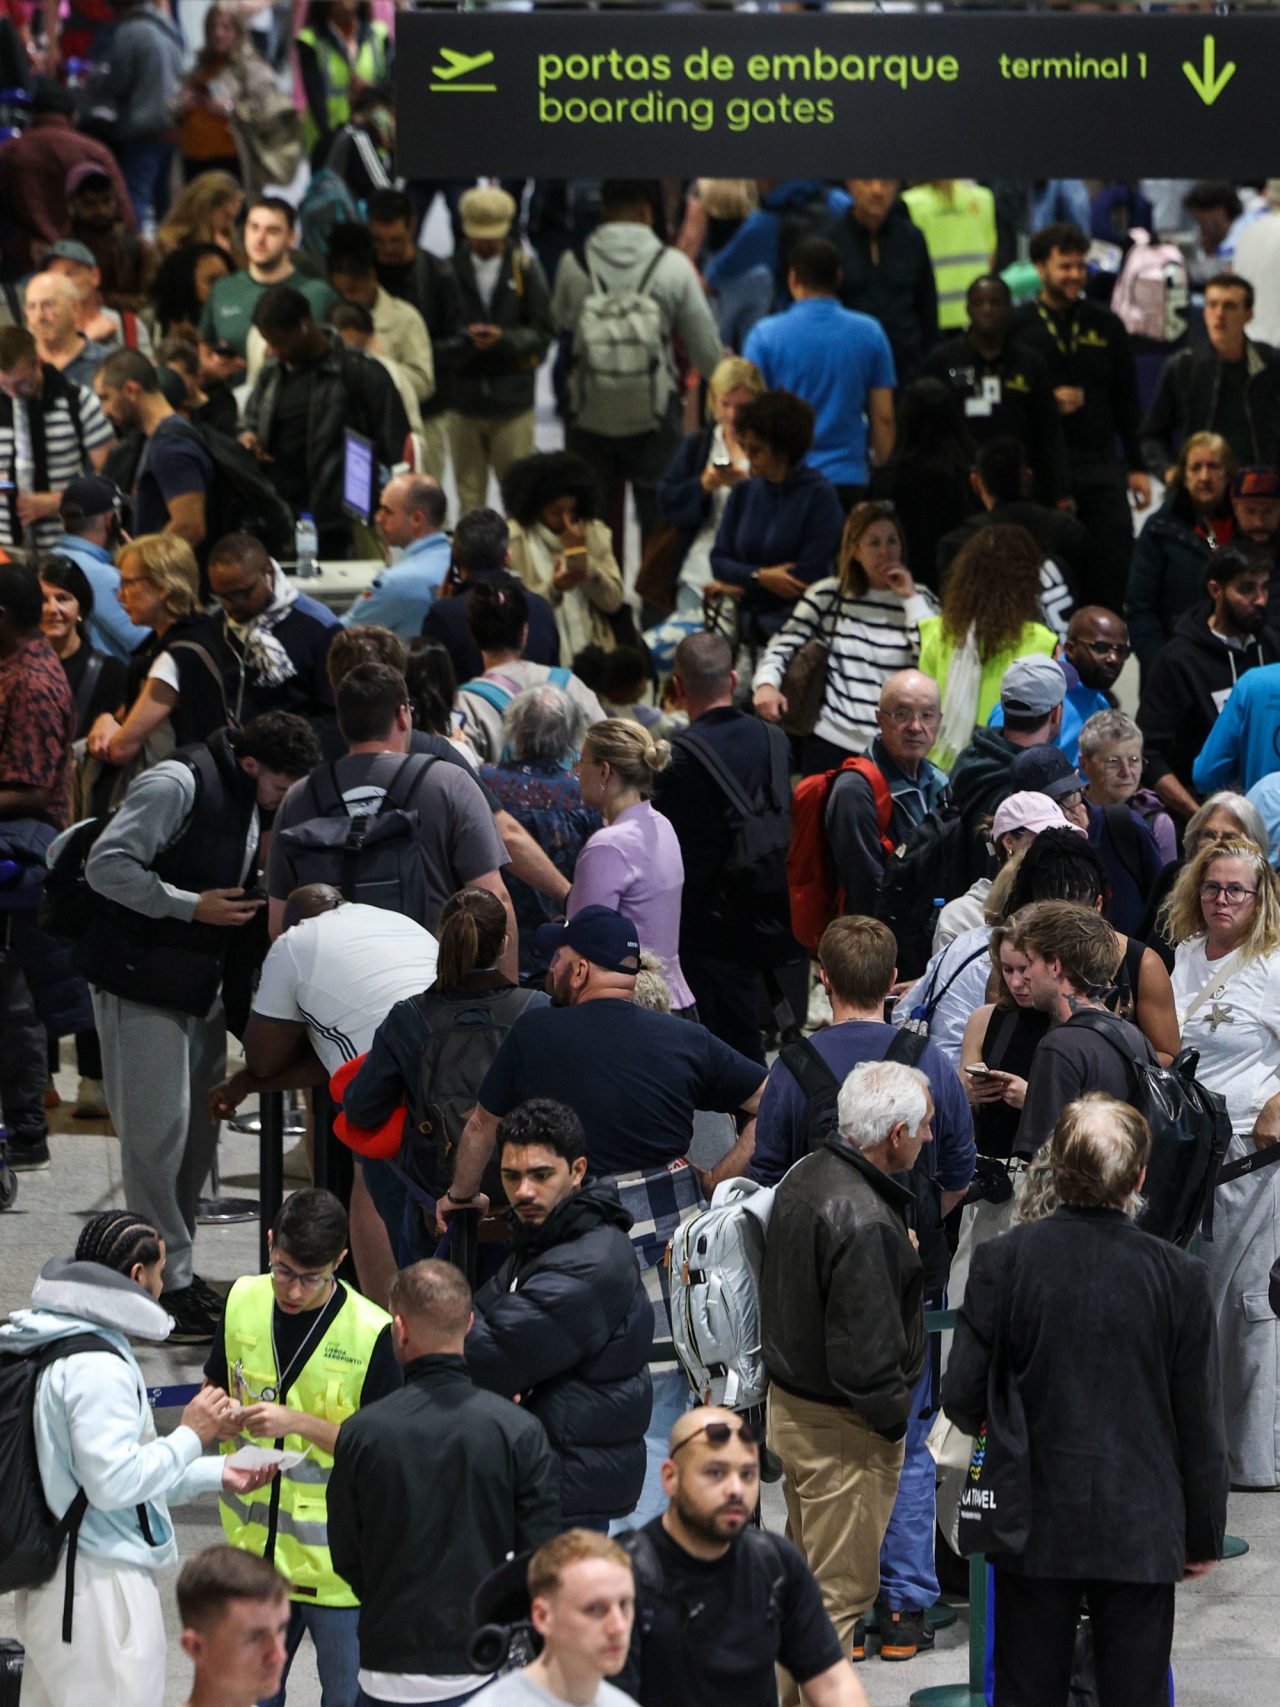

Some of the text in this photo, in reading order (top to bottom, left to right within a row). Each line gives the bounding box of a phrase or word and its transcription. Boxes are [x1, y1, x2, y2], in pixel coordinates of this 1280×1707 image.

[538, 47, 960, 89] portas de embarque
[999, 53, 1147, 80] terminal 1
[538, 91, 834, 131] boarding gates
[324, 1353, 362, 1365] AEROPORTO
